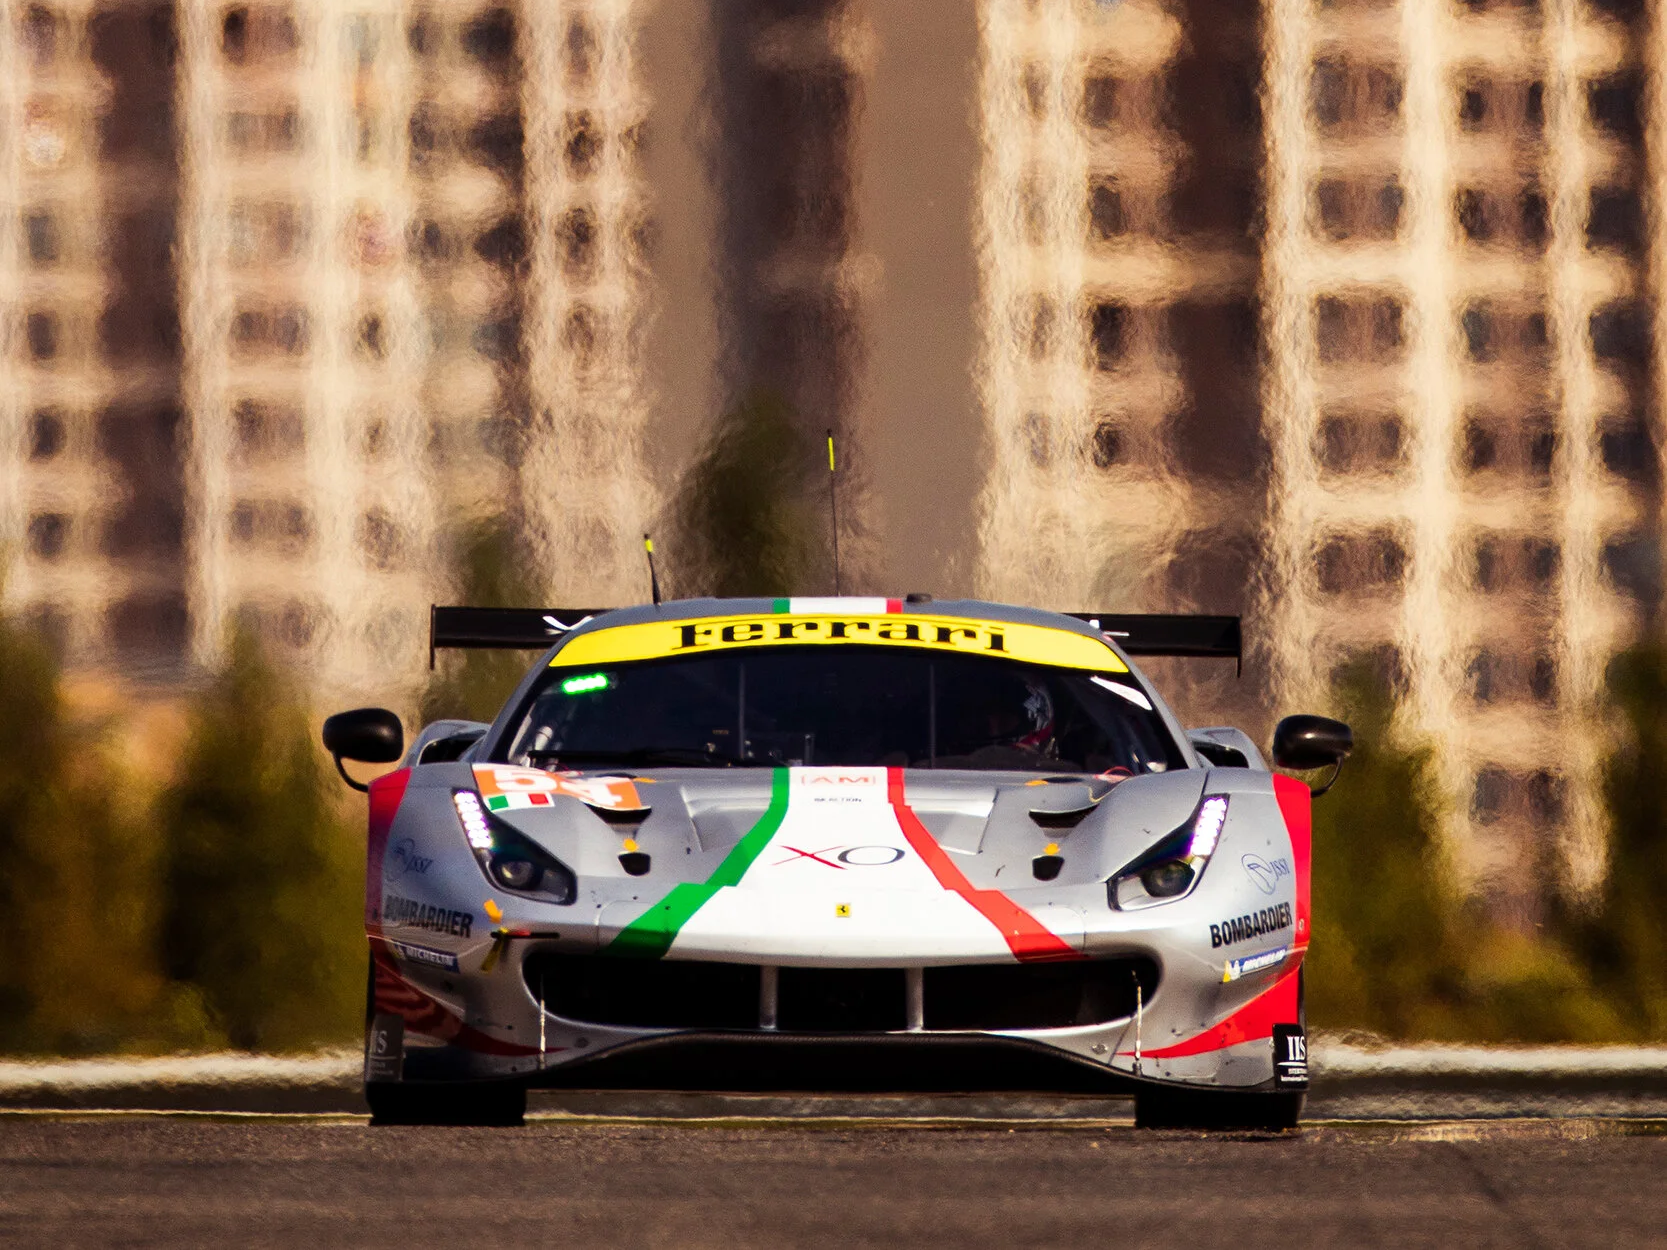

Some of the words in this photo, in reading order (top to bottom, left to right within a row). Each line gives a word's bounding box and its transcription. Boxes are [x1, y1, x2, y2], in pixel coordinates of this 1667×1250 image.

[672, 617, 1009, 653] Ferrari
[494, 766, 623, 807] 54
[772, 845, 905, 870] XO
[383, 894, 474, 938] BOMBARDIER
[1209, 902, 1292, 948] BOMBARDIER
